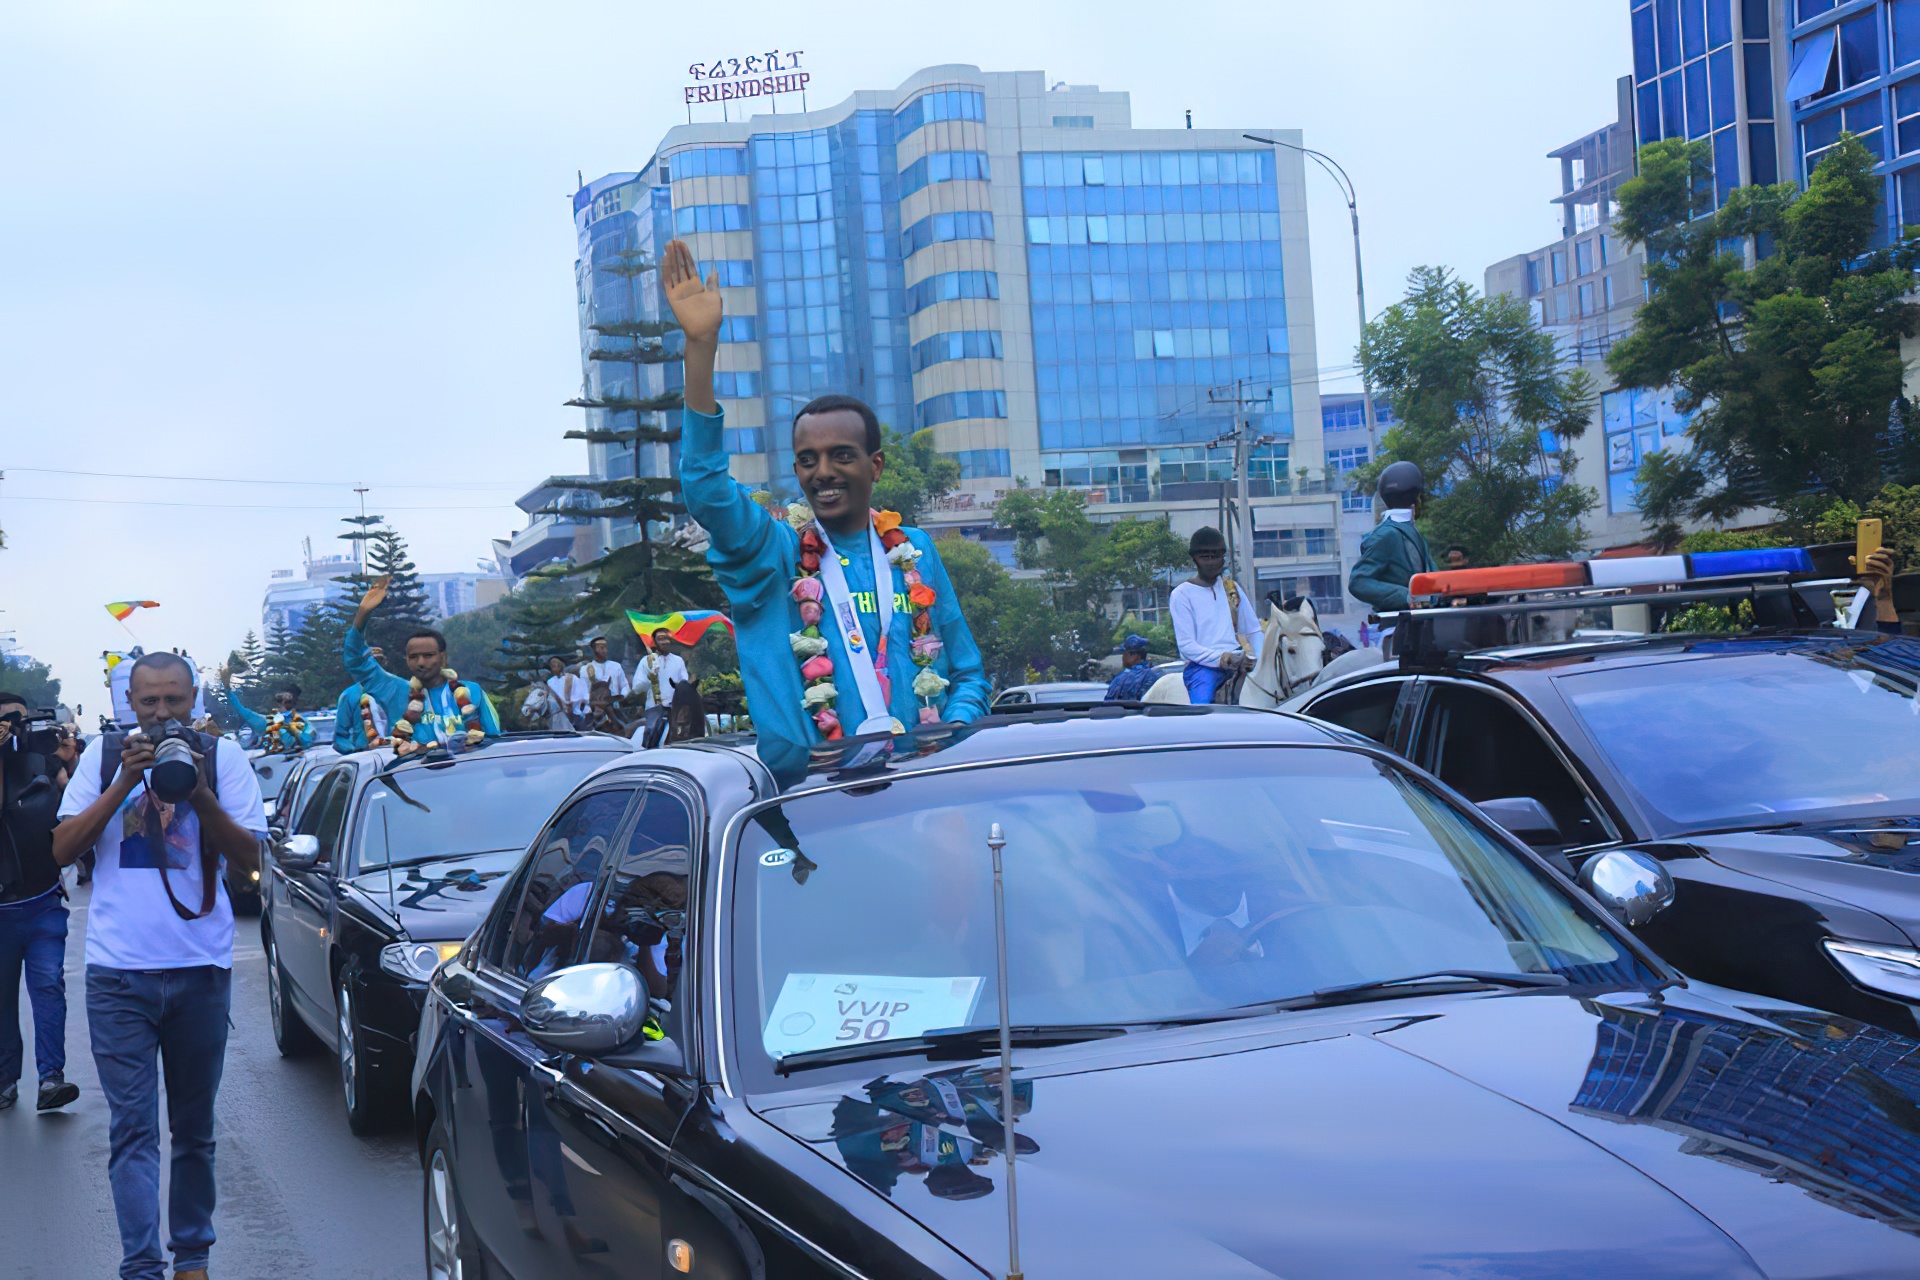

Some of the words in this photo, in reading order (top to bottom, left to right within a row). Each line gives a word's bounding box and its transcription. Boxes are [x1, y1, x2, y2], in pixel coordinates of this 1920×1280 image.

[685, 73, 810, 104] FRIENDSHIP
[838, 1000, 909, 1017] VVIP
[836, 1019, 890, 1041] 50
